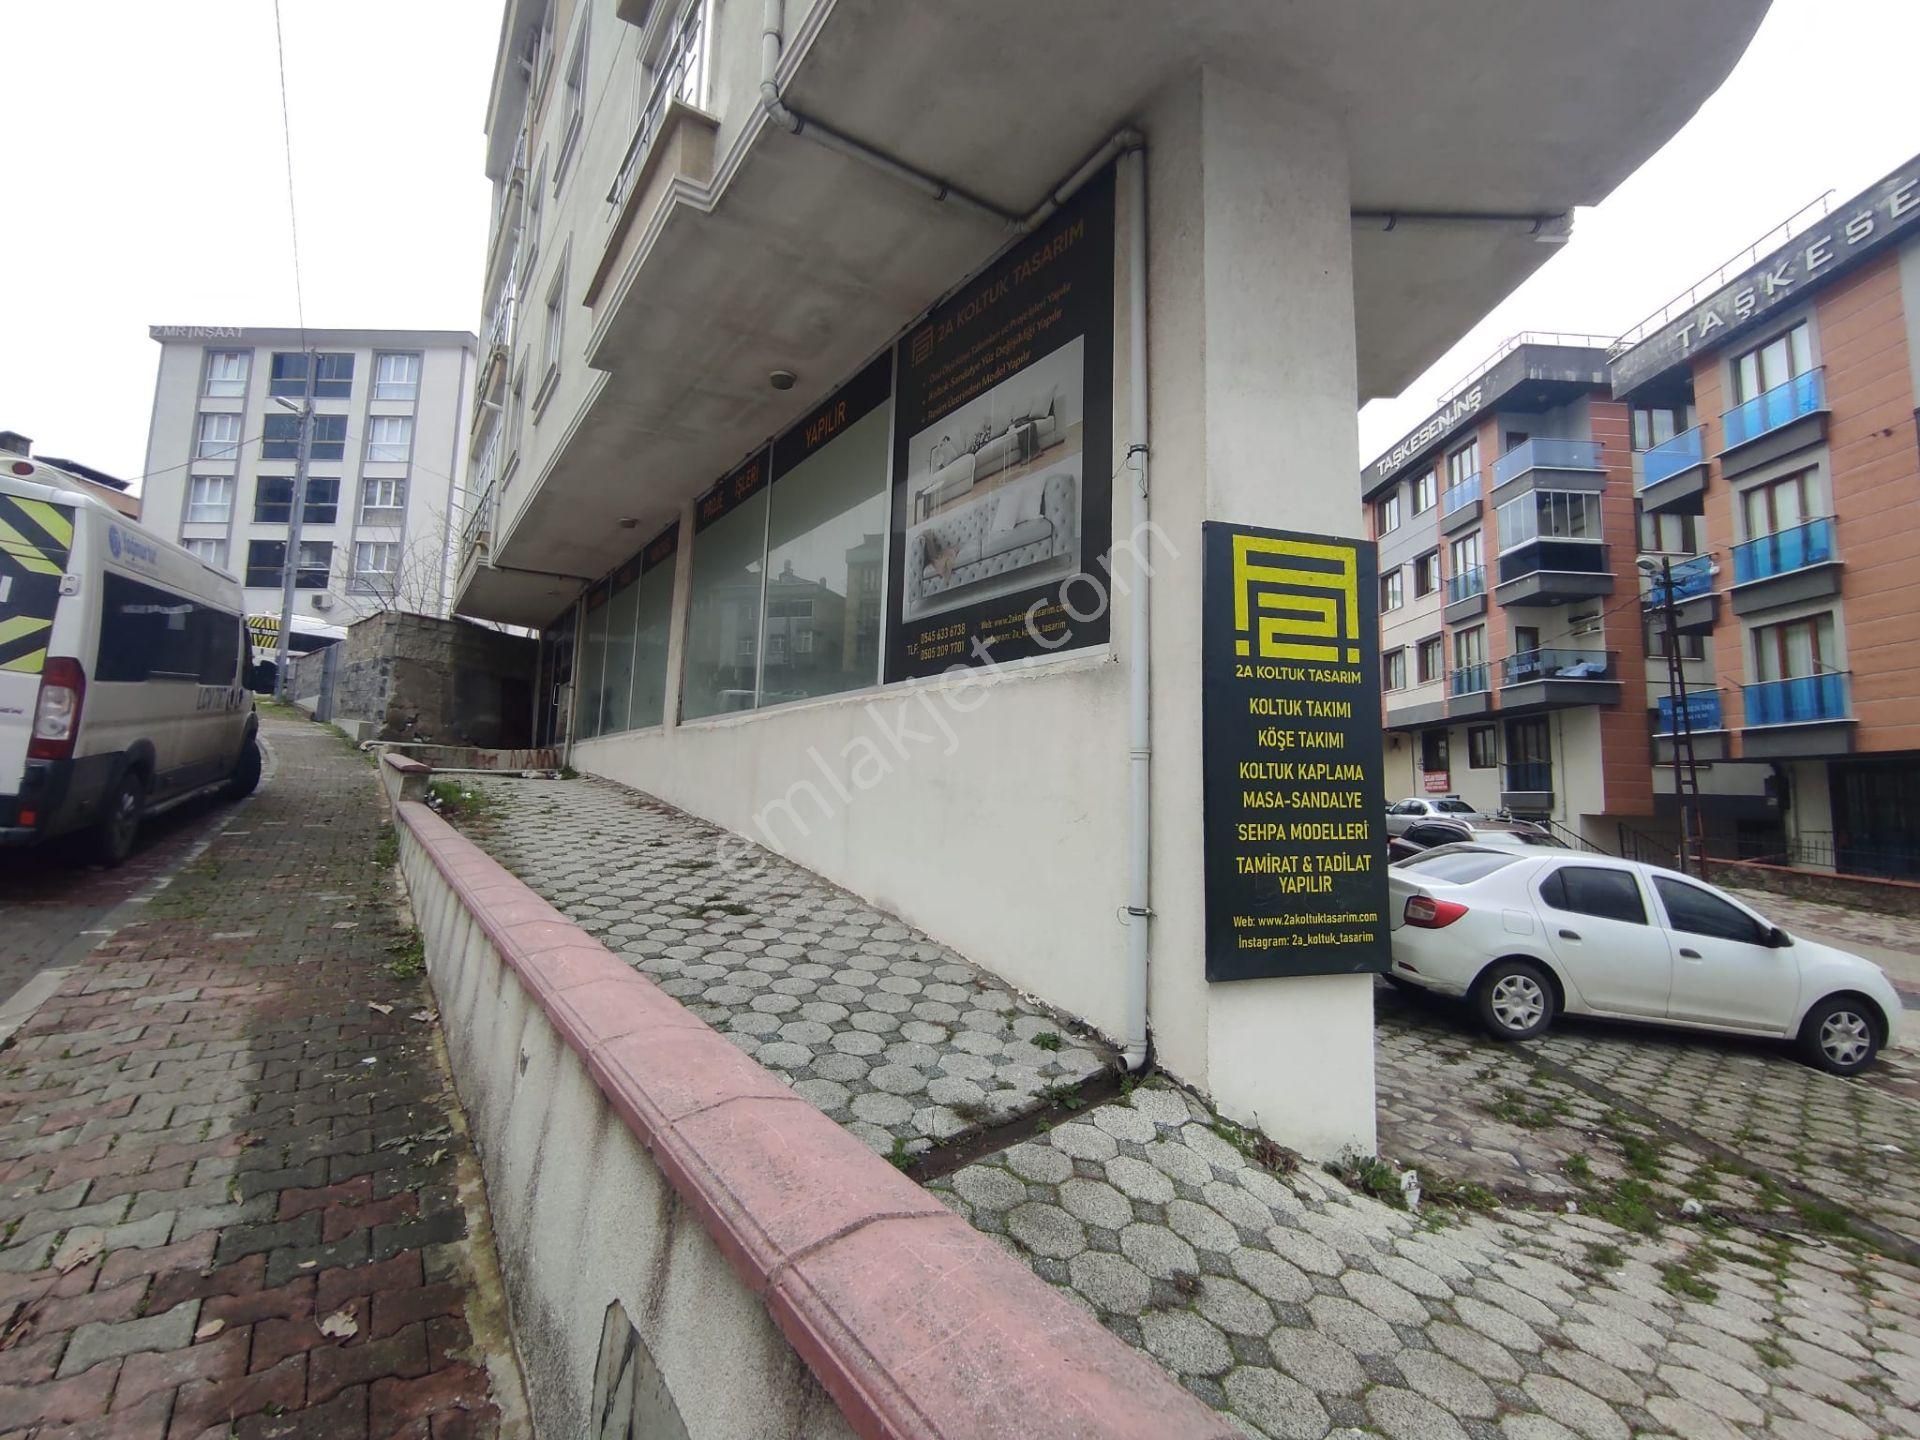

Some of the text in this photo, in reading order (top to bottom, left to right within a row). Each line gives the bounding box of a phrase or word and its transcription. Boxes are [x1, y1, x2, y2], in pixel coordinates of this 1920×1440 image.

[956, 275, 1009, 328] KOLTUK
[1012, 216, 1085, 286] TASARIM
[804, 400, 847, 448] YAPILIR
[1235, 664, 1361, 684] 2A KOLTUK TASARIM
[1249, 697, 1352, 719] KOLTUK TAKIMI
[1258, 726, 1345, 752] KÖŞE TAKIMI
[1239, 762, 1364, 781] KOLTUK KAPLAMA
[1243, 791, 1363, 809] MASA-SANDALYE
[1238, 820, 1368, 841] SEHPA MODELLERİ
[1236, 851, 1372, 874] TAMİRAT & TADİLAT
[1279, 875, 1333, 893] YAPILIR
[1233, 912, 1378, 928] Web: www.2akoltuktasarim.com
[1292, 931, 1374, 947] 2a_koltuk_tasarim
